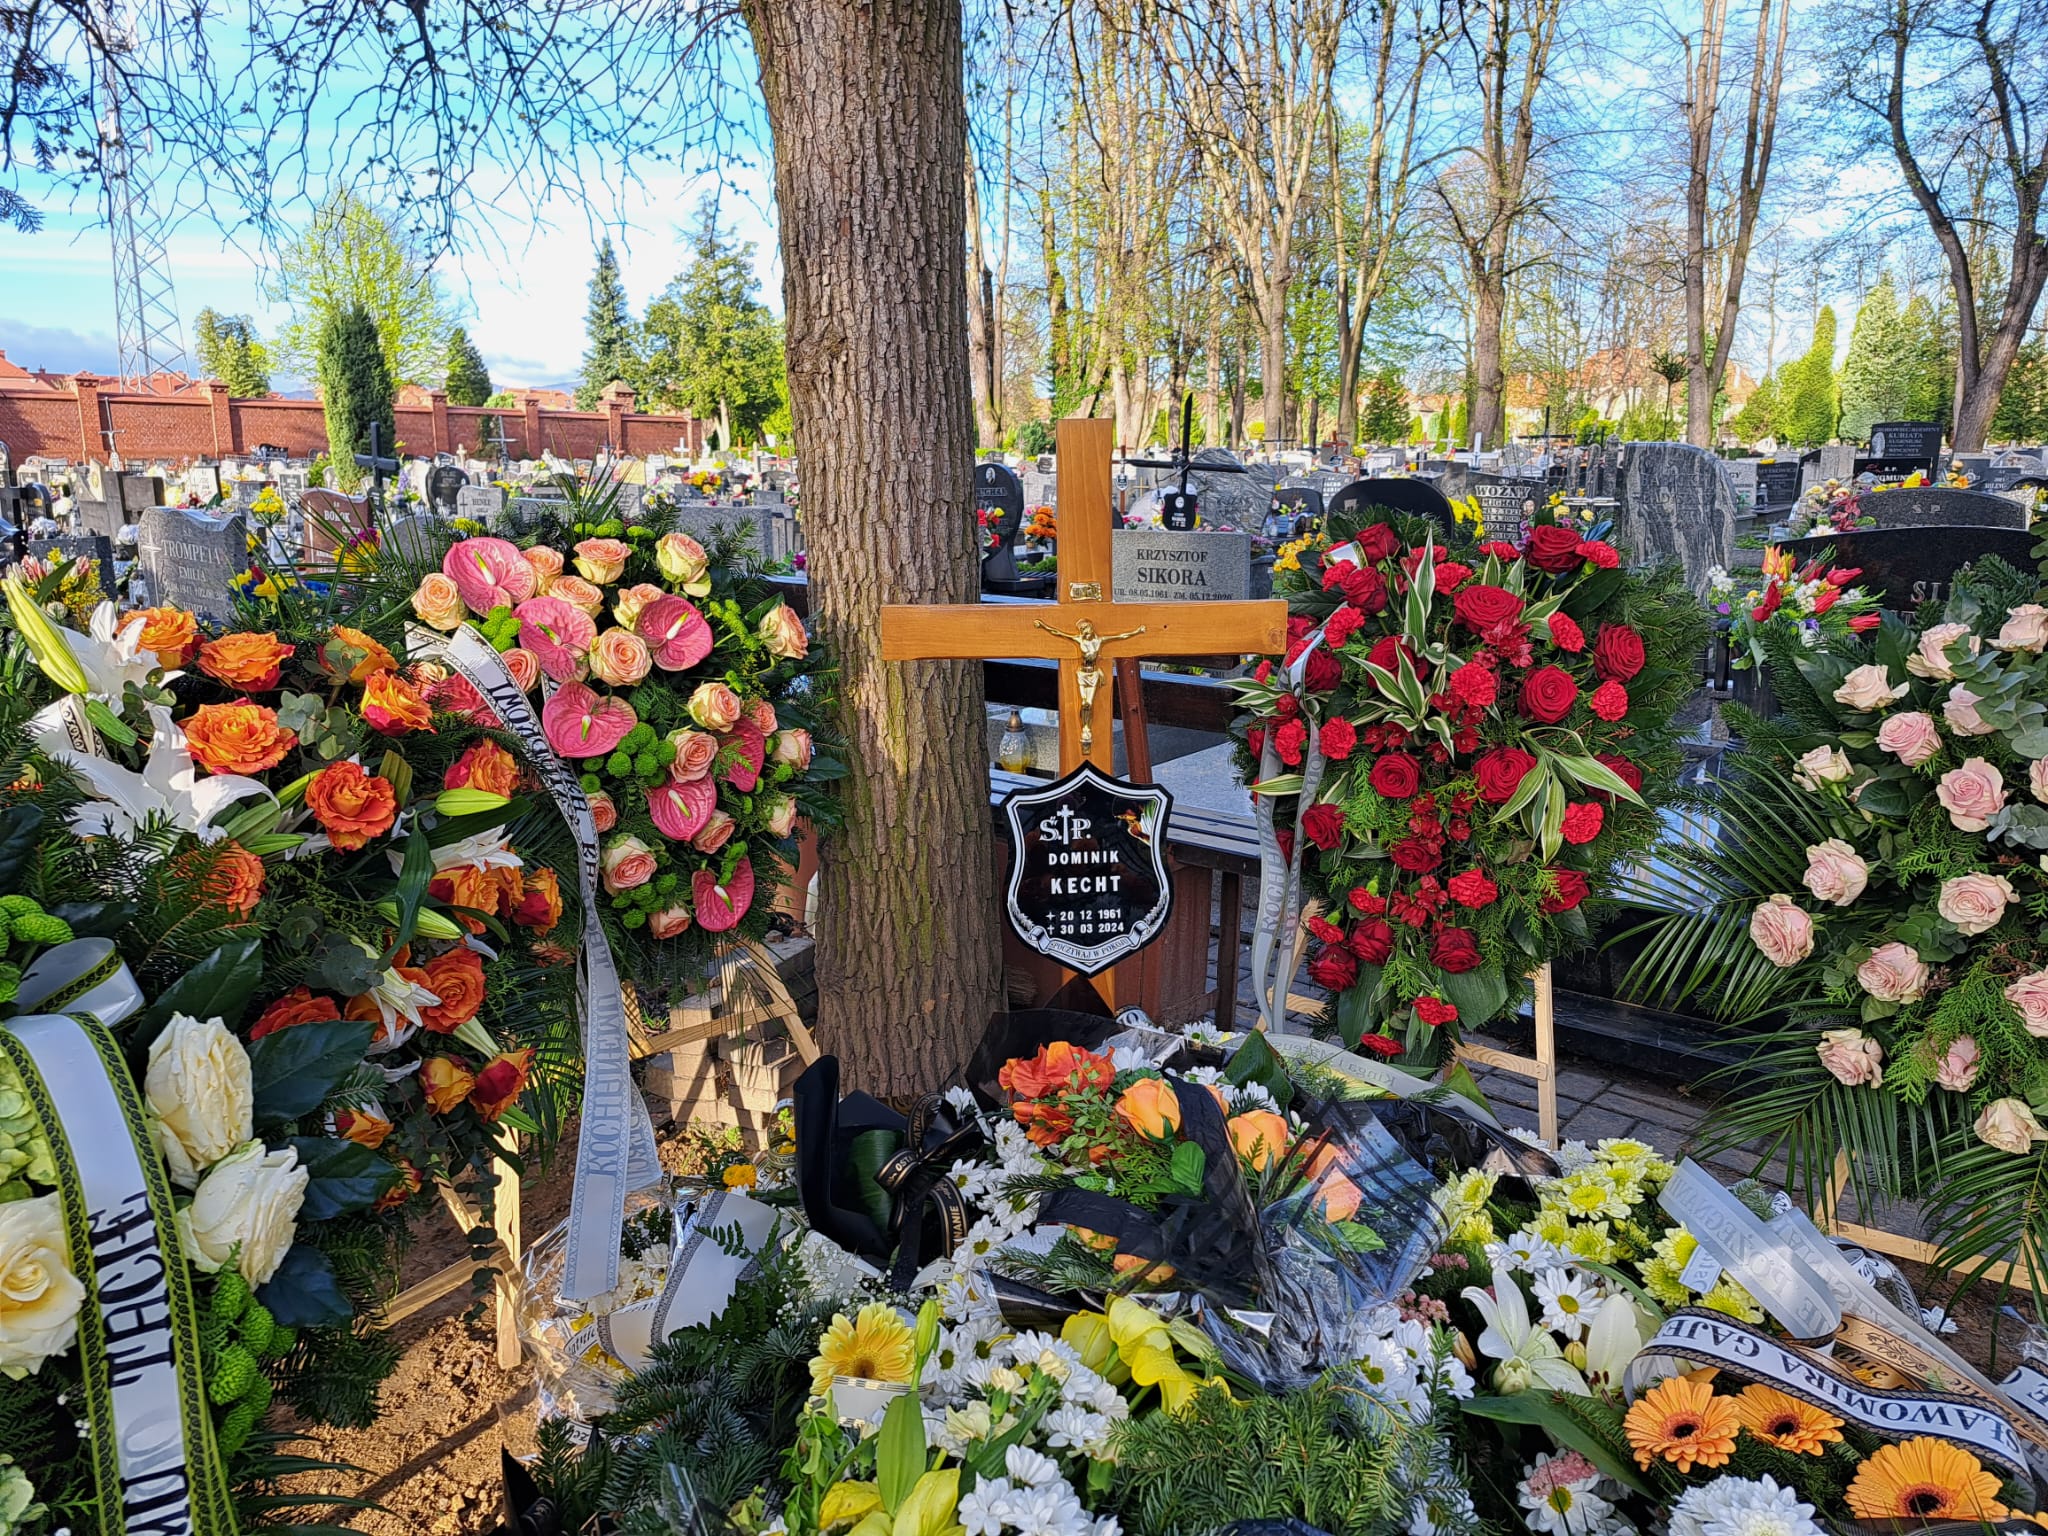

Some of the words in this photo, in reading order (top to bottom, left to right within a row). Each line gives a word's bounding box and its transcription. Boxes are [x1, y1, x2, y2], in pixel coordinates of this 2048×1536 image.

[161, 540, 221, 565] TROMPETA
[1136, 548, 1208, 563] KRZYSZTOF
[178, 565, 207, 582] EMILIA
[1137, 566, 1208, 586] SIKORA
[1048, 850, 1120, 865] DOMINIK
[1050, 875, 1121, 895] KECHT
[1059, 911, 1074, 921] 20
[1079, 910, 1092, 921] 12
[1098, 908, 1121, 920] 1961
[1060, 924, 1074, 934] 30
[1080, 923, 1093, 934] 03
[1098, 922, 1124, 933] 2024
[87, 1190, 177, 1388] TACIE
[1660, 1315, 1760, 1358] GAJE
[1780, 1351, 2020, 1455] SŁAWOMIRA
